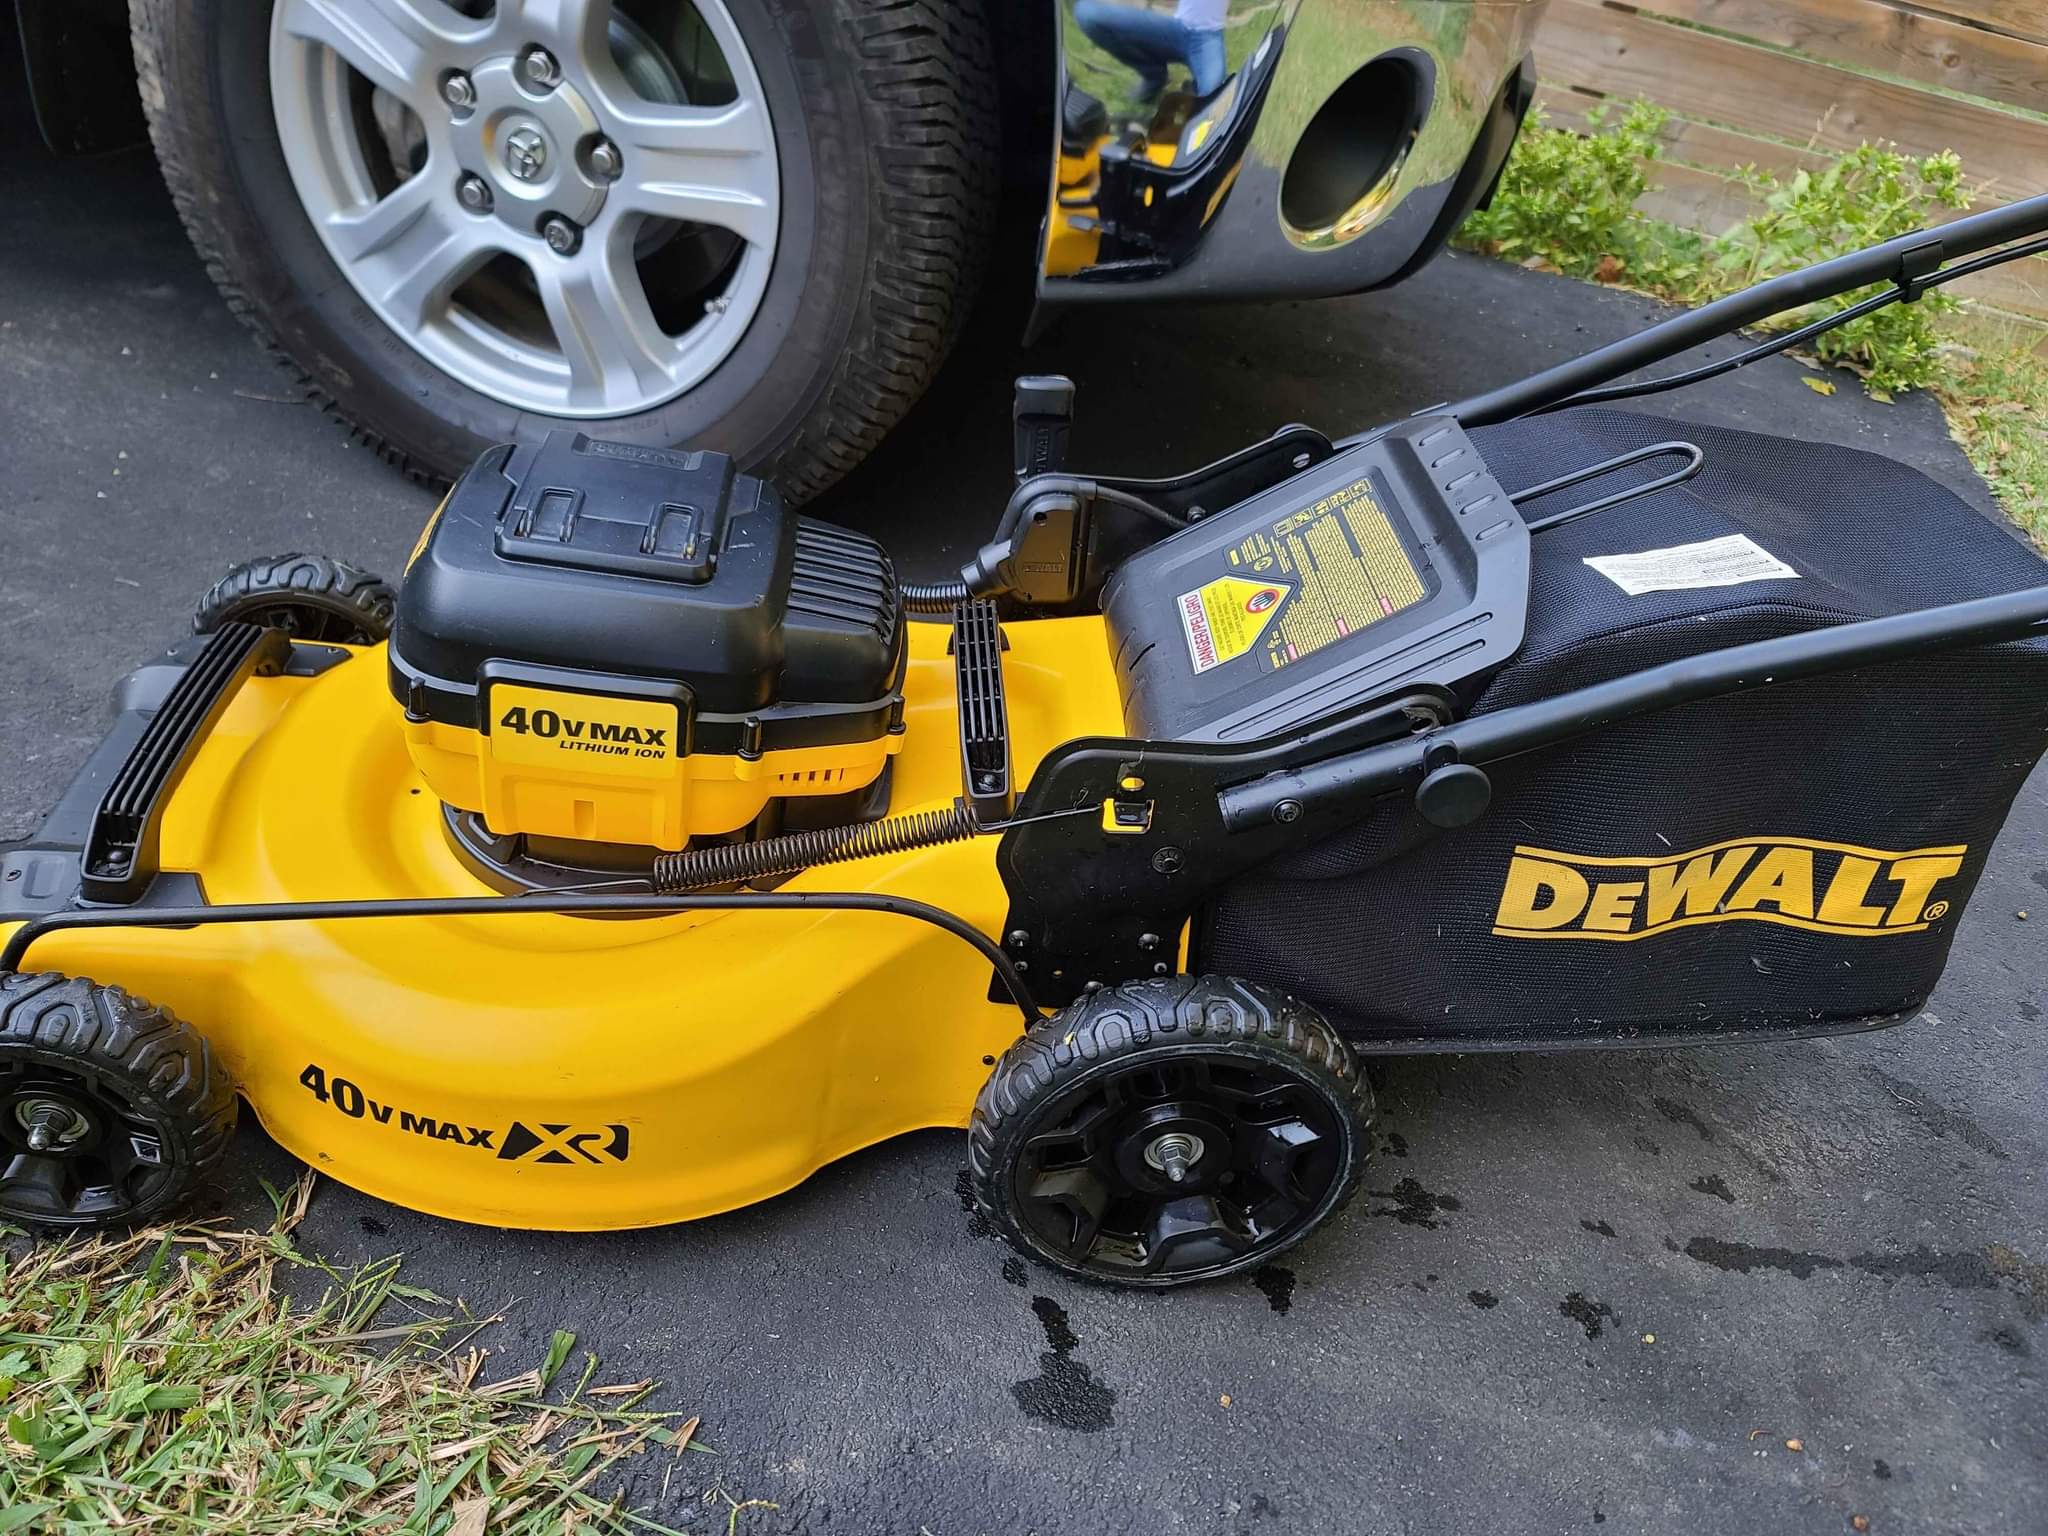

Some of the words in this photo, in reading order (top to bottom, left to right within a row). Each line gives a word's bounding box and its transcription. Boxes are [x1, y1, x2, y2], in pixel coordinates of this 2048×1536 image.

[1184, 593, 1216, 669] DANGER/PELIGRO
[559, 740, 630, 756] LITHIUM
[634, 748, 666, 760] ION
[590, 722, 667, 747] MAX
[1495, 846, 1963, 933] DEWALT
[400, 1110, 496, 1150] MAX
